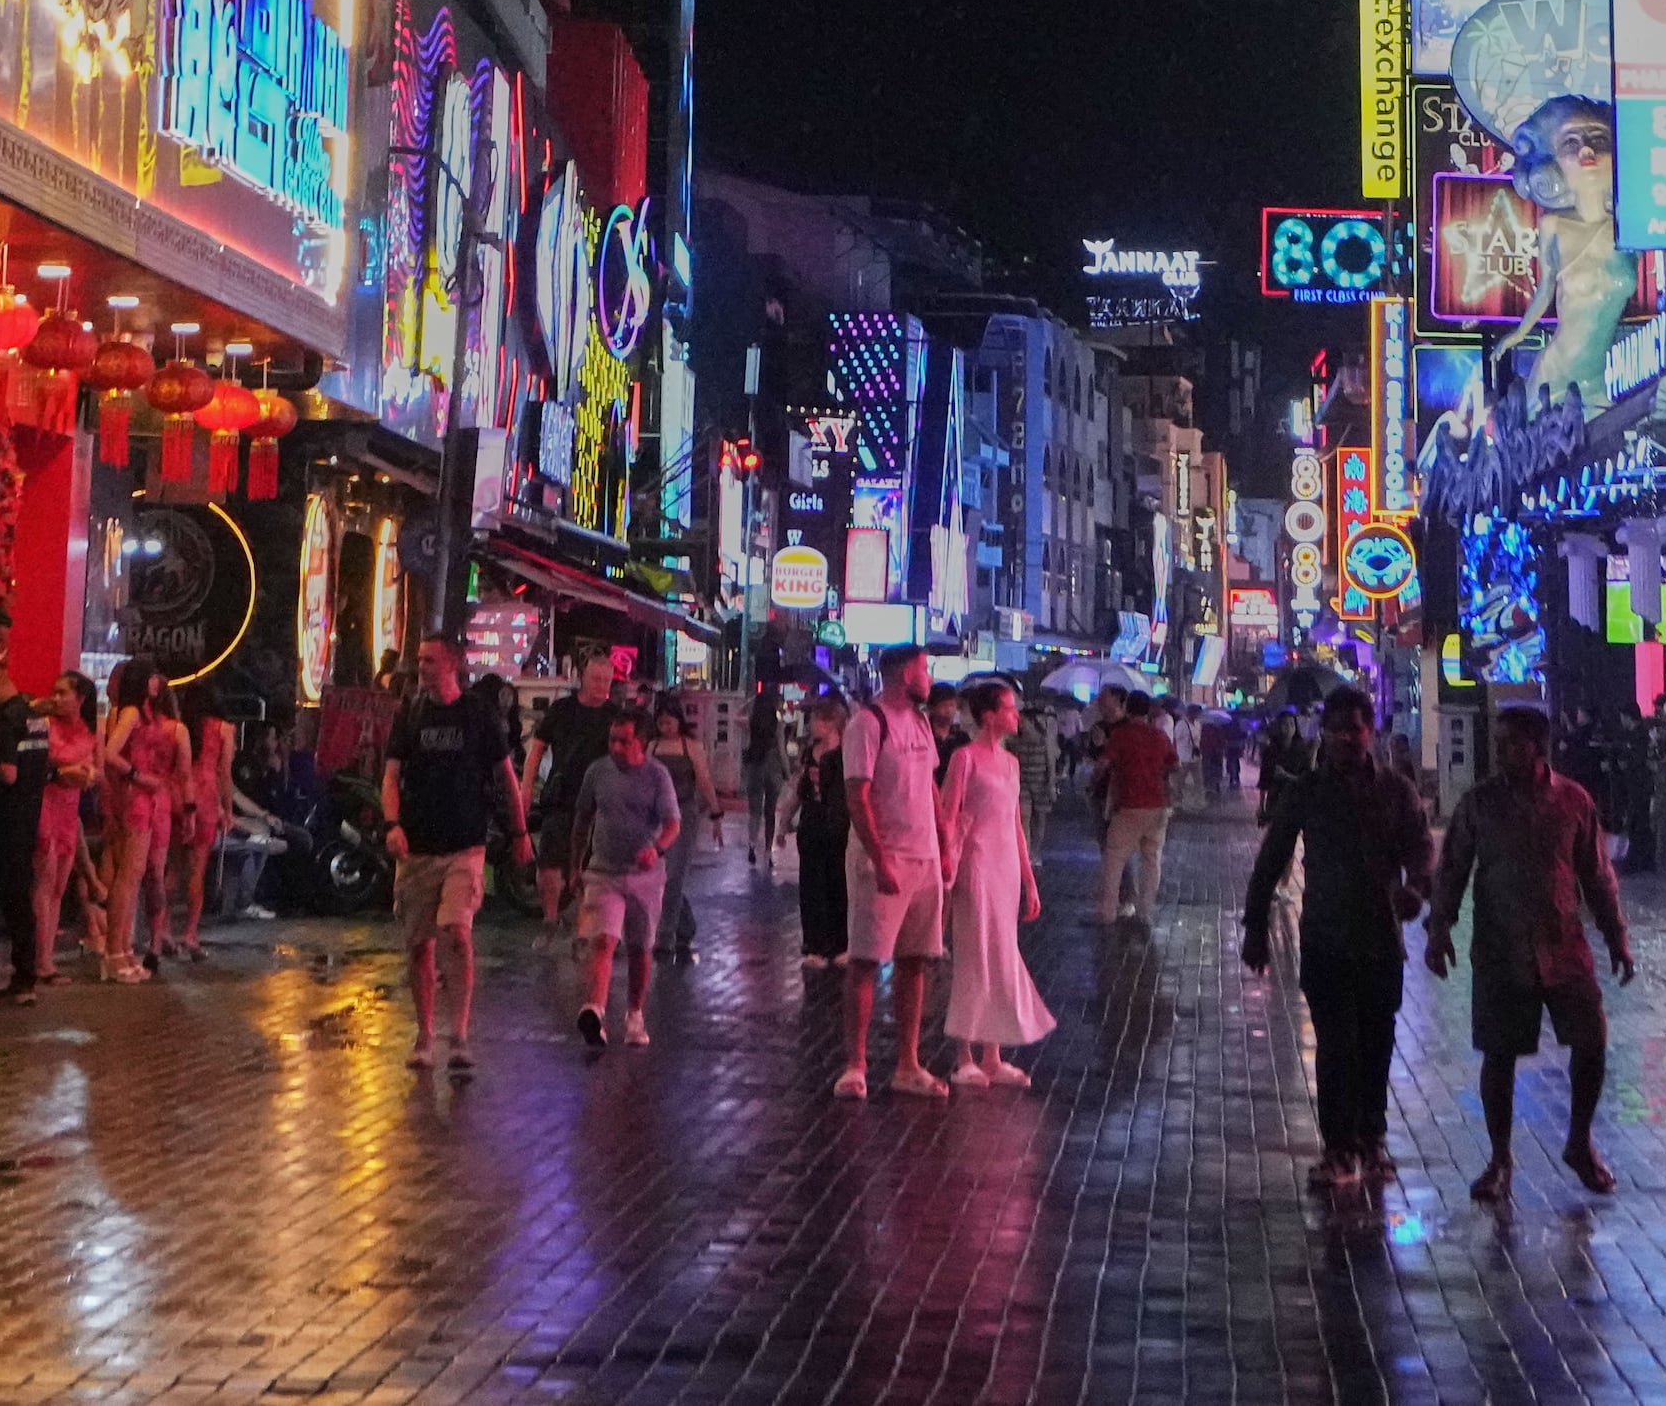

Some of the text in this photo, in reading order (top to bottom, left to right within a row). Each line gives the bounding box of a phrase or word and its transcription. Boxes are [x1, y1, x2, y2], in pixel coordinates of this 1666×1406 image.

[1422, 96, 1473, 134] ST
[1459, 130, 1495, 147] CLU
[1082, 238, 1200, 275] JANNAAT
[1475, 256, 1530, 277] CLUB
[1294, 288, 1322, 302] FIRST
[1325, 288, 1356, 303] CLASS
[788, 492, 824, 512] Girls
[775, 566, 824, 578] BURGER
[774, 579, 823, 594] KING
